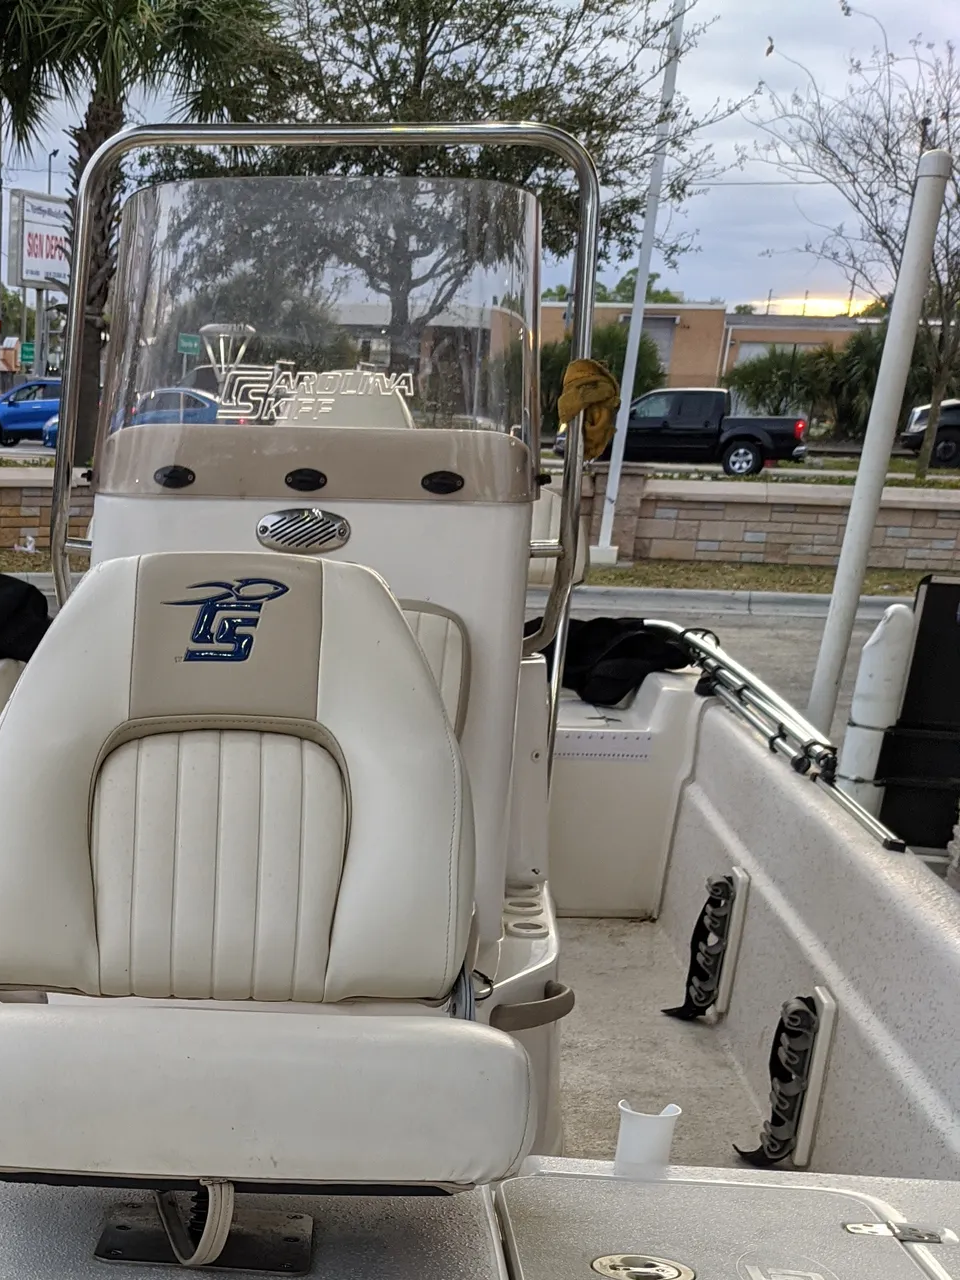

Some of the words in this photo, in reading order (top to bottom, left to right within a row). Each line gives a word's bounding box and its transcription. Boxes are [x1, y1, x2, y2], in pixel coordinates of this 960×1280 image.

[26, 232, 44, 260] SIGN
[216, 382, 336, 420] SKIFF
[221, 370, 414, 406] CAROLINA
